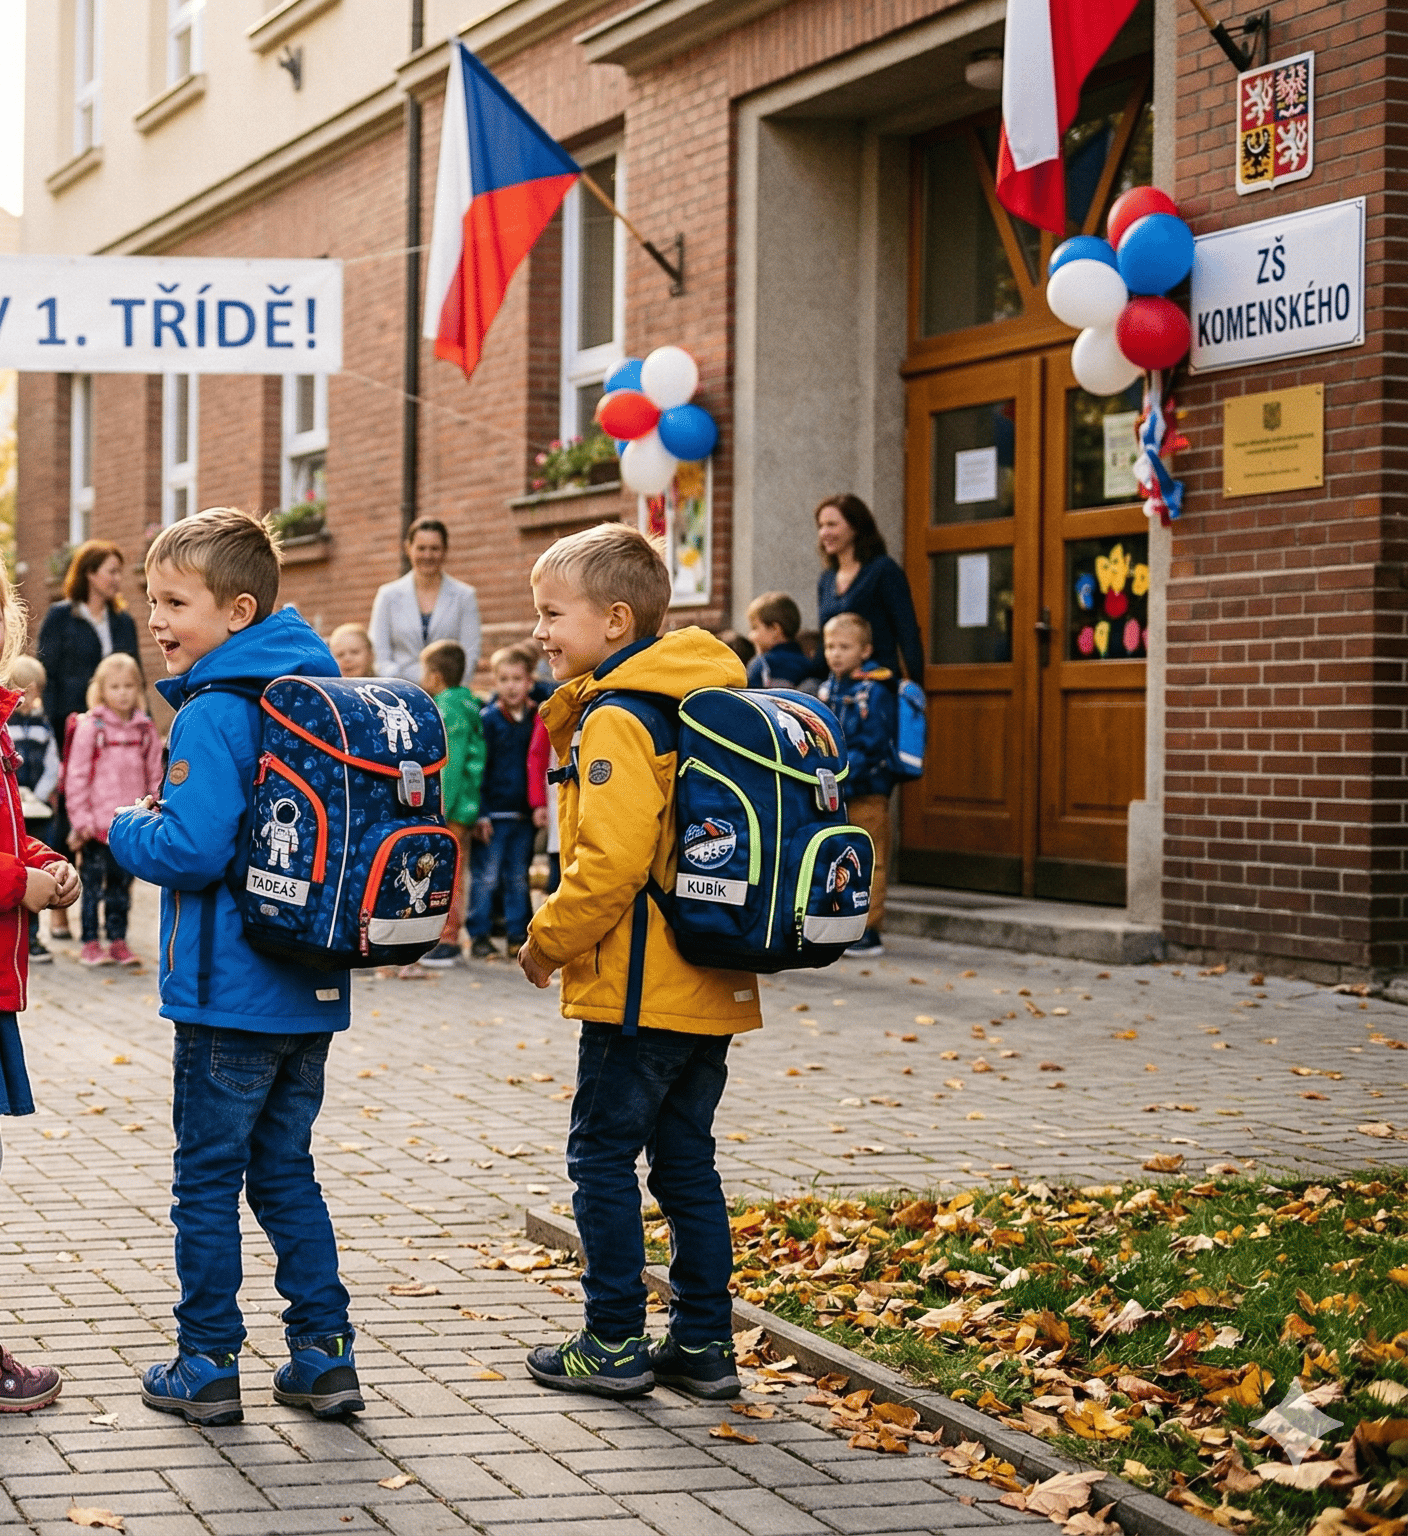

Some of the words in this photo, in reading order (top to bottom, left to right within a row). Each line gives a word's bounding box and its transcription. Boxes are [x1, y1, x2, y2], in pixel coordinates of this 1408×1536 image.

[1256, 234, 1287, 285] ZŠ
[36, 297, 87, 347] 1.
[110, 282, 317, 349] TŘÍDĚ!
[1197, 280, 1351, 348] KOMENSKÉHO
[252, 874, 297, 898] TADEÁŠ
[687, 880, 727, 898] KUBÍK
